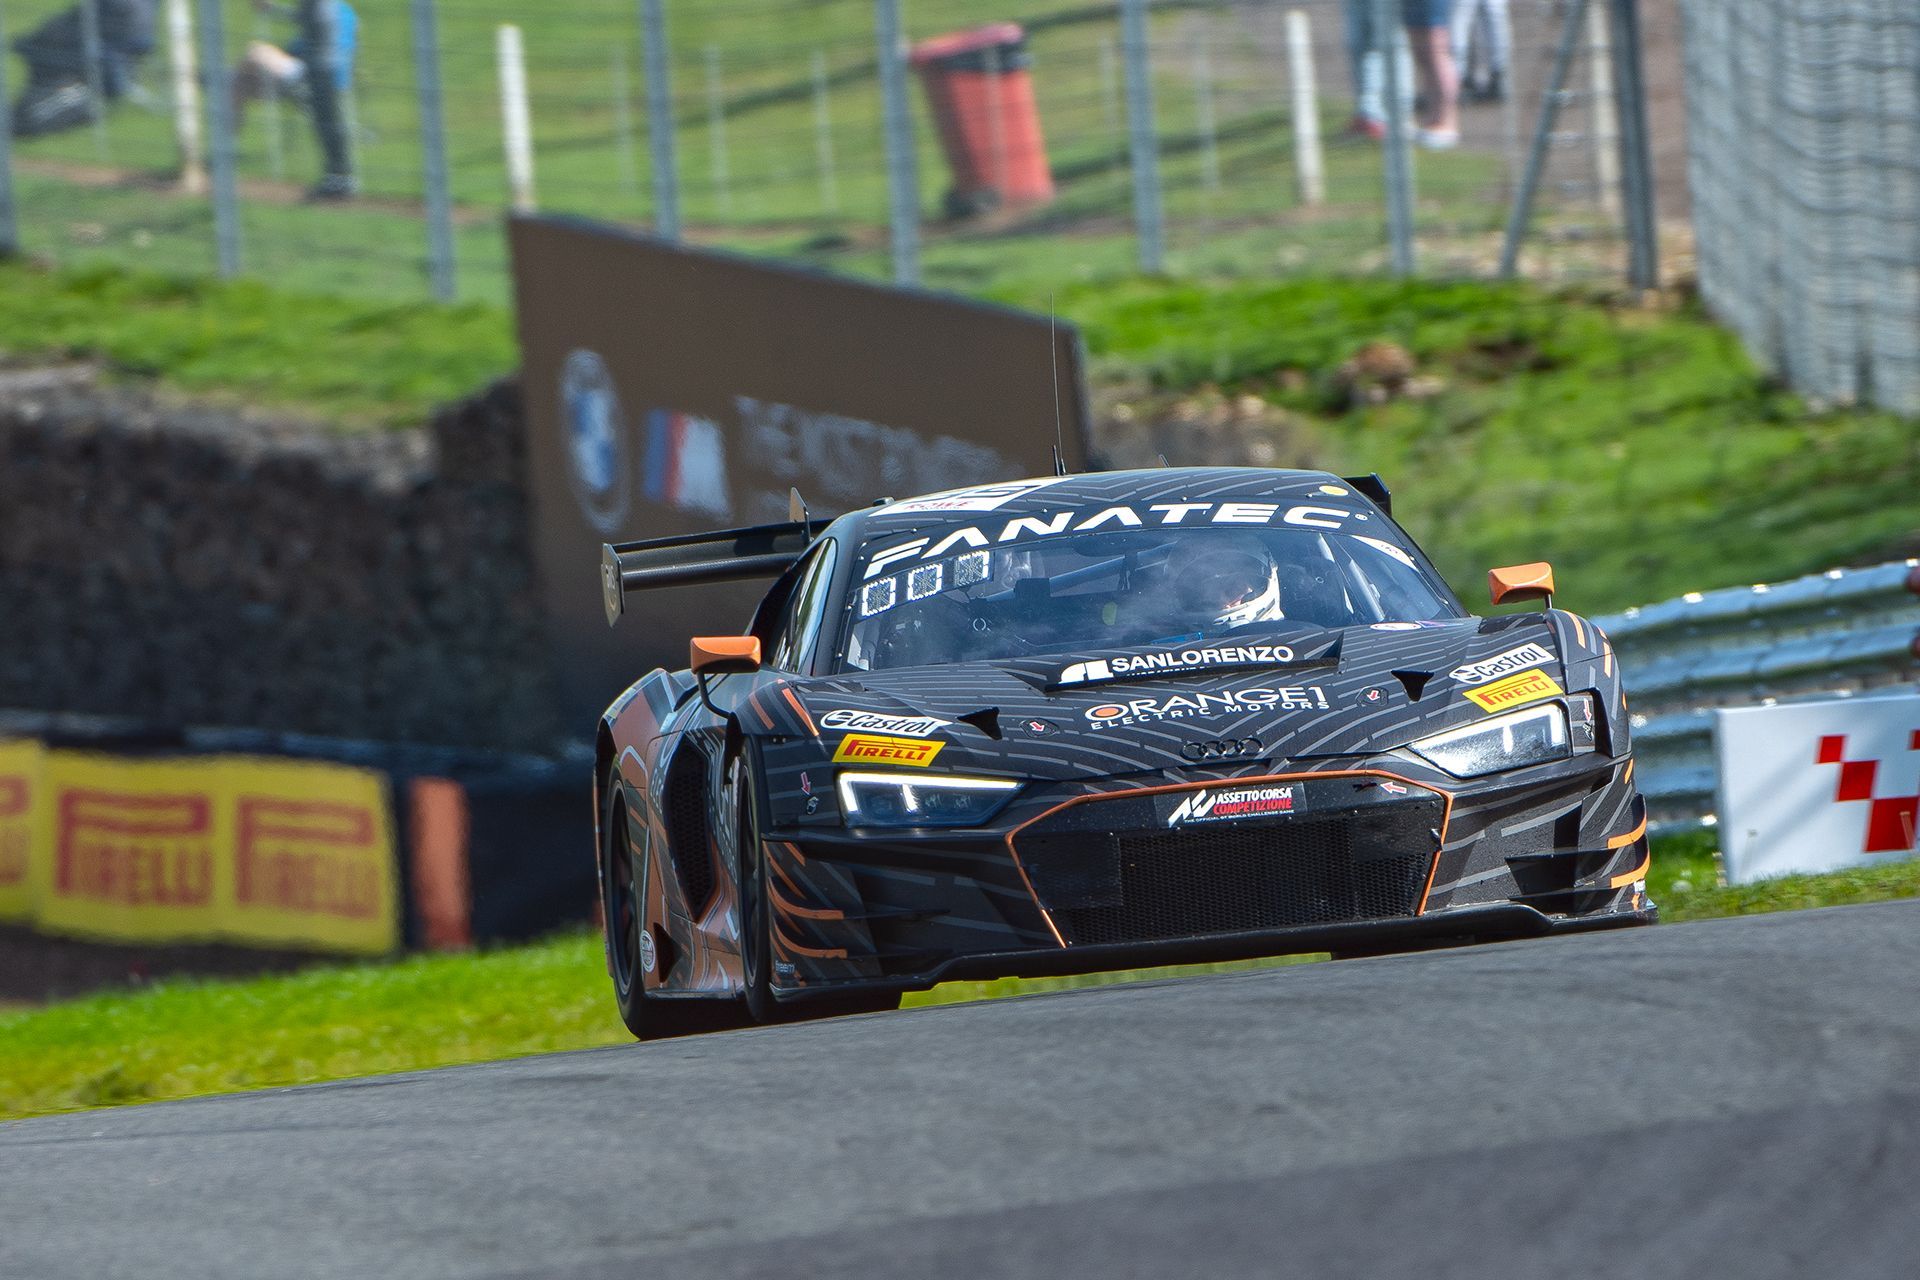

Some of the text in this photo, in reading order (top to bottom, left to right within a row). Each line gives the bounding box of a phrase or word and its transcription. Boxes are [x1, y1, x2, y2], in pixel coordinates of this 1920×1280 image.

[863, 503, 1350, 580] FANATEC
[1112, 646, 1294, 672] SANLORENZO
[1475, 648, 1547, 677] Castrol
[1085, 686, 1326, 721] ORANGE1
[1477, 675, 1550, 706] PIRELLI
[847, 714, 935, 733] Castrol
[1091, 701, 1330, 730] ELECTRIC MOTORS
[843, 739, 932, 761] PIRELLI
[1213, 798, 1292, 815] COMPETIZIONE
[1216, 787, 1292, 804] ASSETTO CORSA
